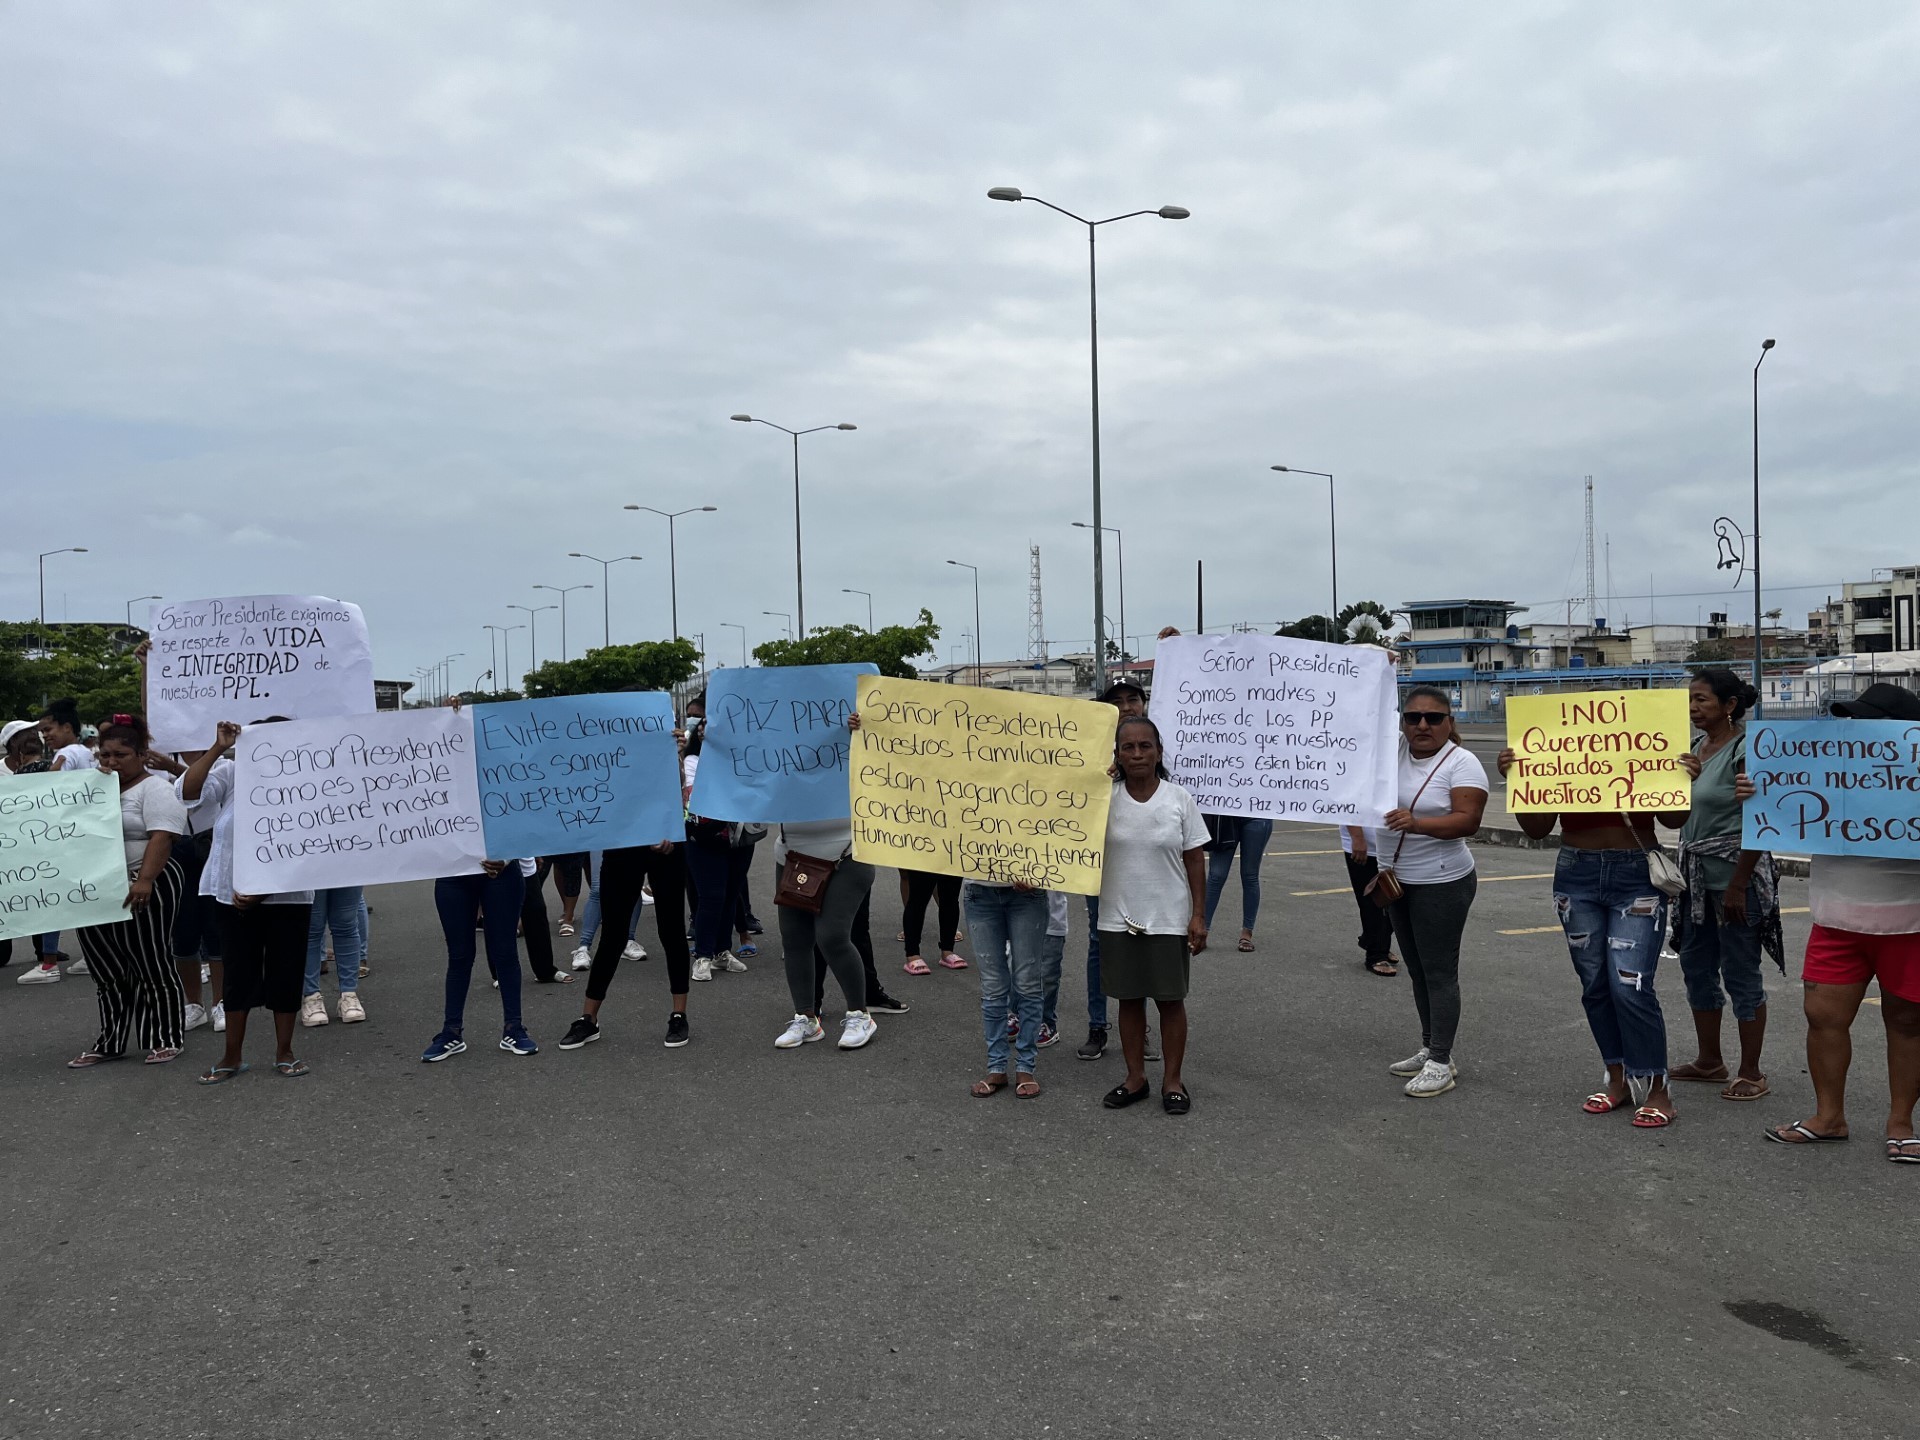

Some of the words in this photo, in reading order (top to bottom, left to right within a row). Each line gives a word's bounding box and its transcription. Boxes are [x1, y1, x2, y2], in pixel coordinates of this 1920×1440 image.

[158, 607, 207, 631] Señor
[209, 600, 287, 627] Presidente
[291, 607, 350, 627] exigimos
[162, 639, 177, 653] se
[181, 631, 230, 654] respete
[240, 627, 255, 646] la
[263, 627, 326, 648] VIDA
[162, 665, 172, 678] e
[178, 652, 299, 678] INTEGRIDAD
[314, 654, 332, 671] de
[1200, 649, 1254, 673] Señor
[161, 681, 216, 701] nuestros
[222, 676, 270, 699] PPL.
[1177, 681, 1236, 705] Somos
[1248, 681, 1315, 702] madres
[1323, 690, 1336, 707] y
[716, 693, 782, 734] PAZ
[791, 698, 851, 734] PARA
[866, 689, 942, 726] Señor
[945, 699, 1078, 741] Presidente
[1176, 707, 1227, 727] Padres
[1234, 707, 1254, 728] de
[1310, 710, 1333, 729] PP
[481, 712, 559, 750] Evite
[566, 712, 667, 740] derramar
[1254, 733, 1280, 754] que
[1522, 726, 1669, 754] Queremos
[1753, 727, 1900, 762] Queremos
[252, 742, 340, 778] Señor
[339, 732, 465, 767] Presidente
[730, 742, 850, 778] ECUADOR
[863, 729, 954, 758] nuestros
[962, 734, 1084, 768] familiares
[482, 753, 546, 785] más
[1295, 754, 1326, 771] bien
[1336, 761, 1347, 776] y
[1513, 753, 1613, 778] Traslados
[1625, 758, 1678, 784] para
[362, 762, 452, 802] posible
[860, 762, 925, 792] estan
[937, 778, 1047, 811] pagando
[1056, 790, 1088, 810] su
[1608, 776, 1690, 809] Presos.
[1752, 770, 1811, 796] para
[0, 782, 106, 815] esidente
[483, 783, 615, 818] QUEREMOS
[1249, 796, 1271, 812] Paz
[1276, 799, 1286, 815] y
[1289, 800, 1307, 812] no
[254, 812, 293, 846] que
[383, 789, 449, 817] matar
[556, 807, 606, 832] PAZ
[1018, 817, 1087, 842] seres
[276, 834, 372, 859] nuestros
[377, 815, 480, 847] familiares
[853, 820, 936, 853] Humanos
[942, 837, 953, 865] y
[957, 833, 1038, 862] tambien
[1040, 841, 1101, 869] tienen
[960, 853, 1065, 884] DERECHOS
[67, 878, 99, 904] de
